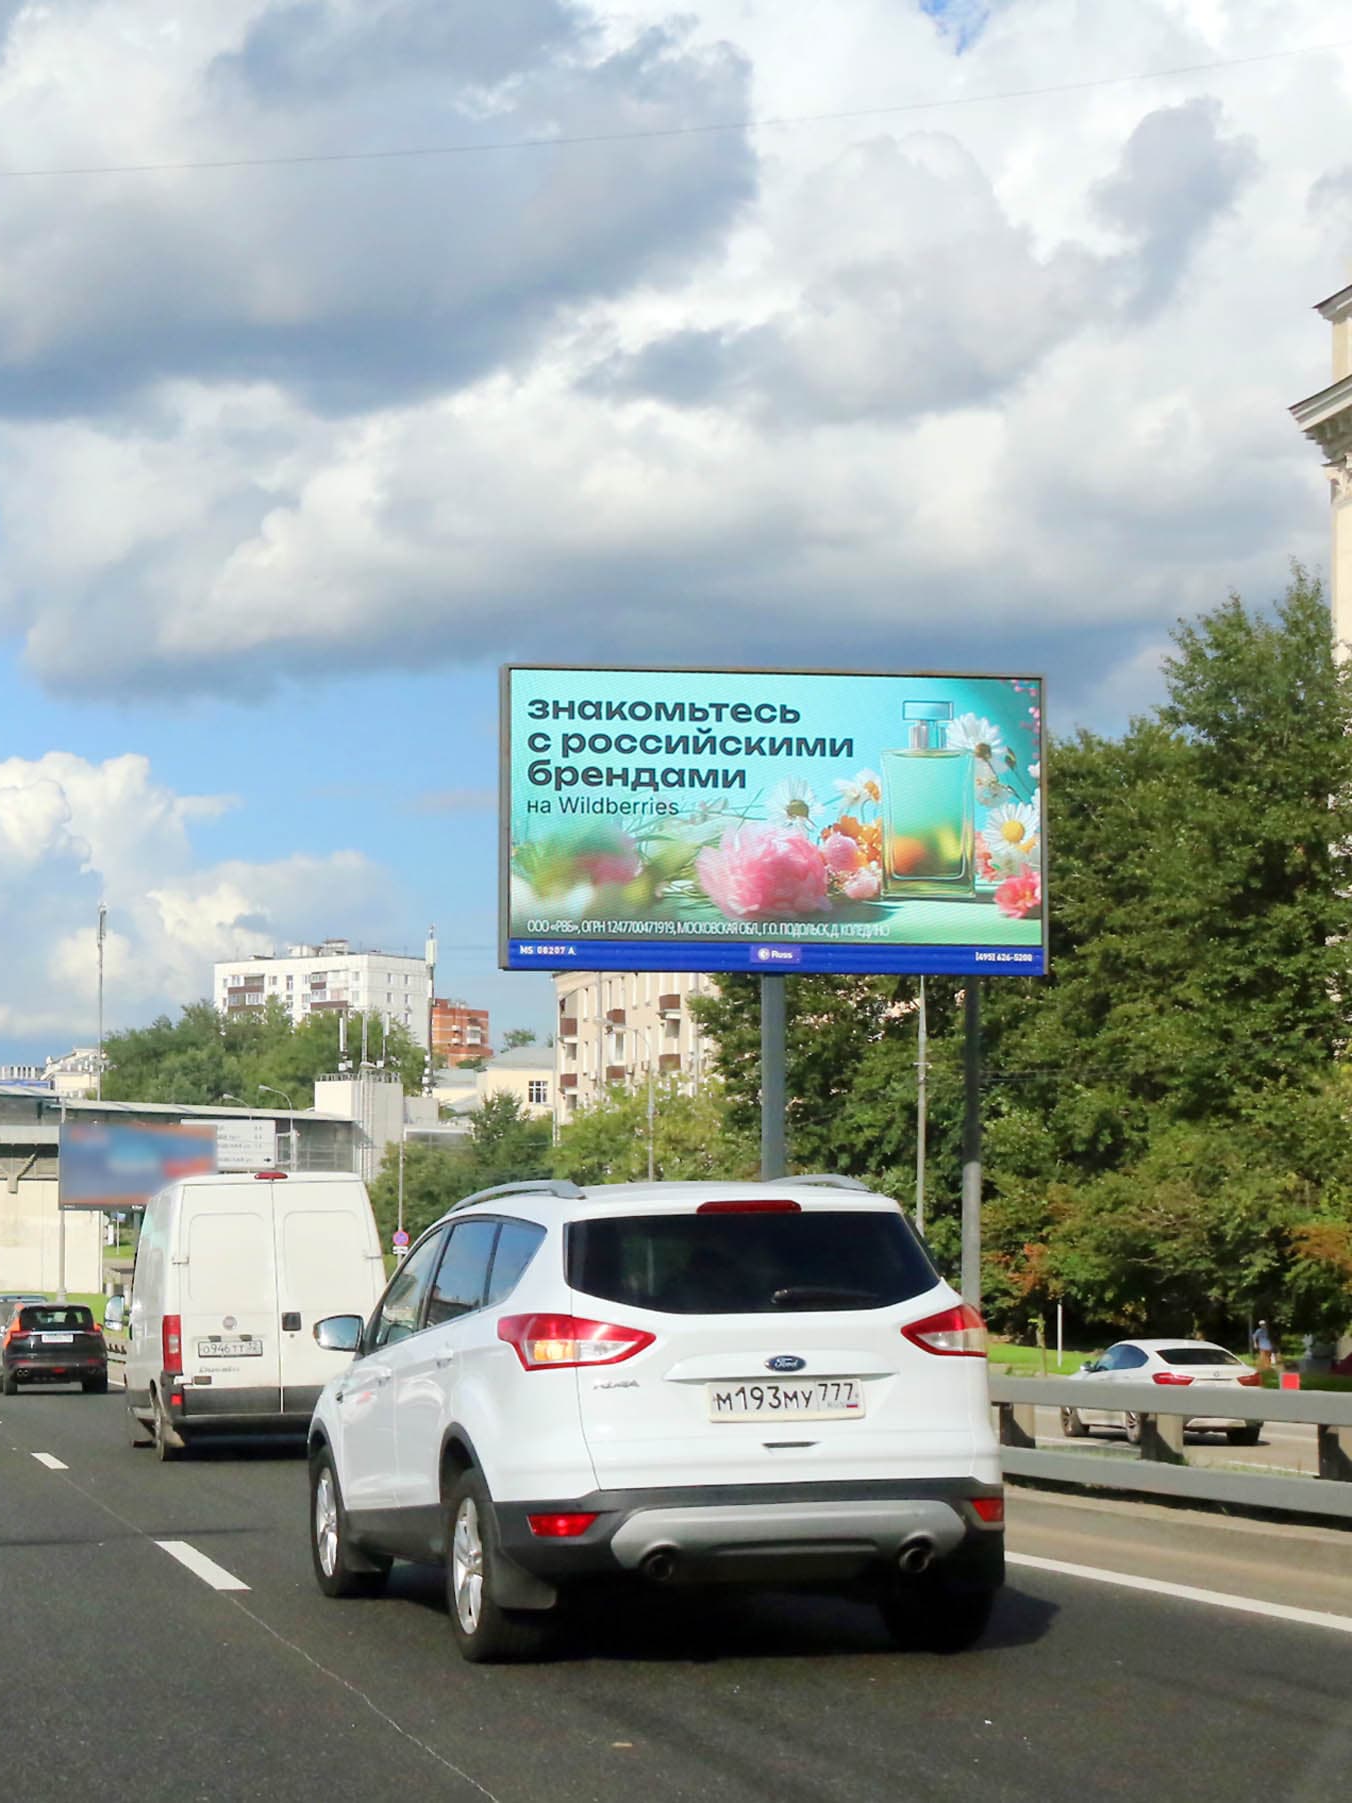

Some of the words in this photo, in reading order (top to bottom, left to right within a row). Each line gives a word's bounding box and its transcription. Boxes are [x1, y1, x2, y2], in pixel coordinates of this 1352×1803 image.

[527, 699, 801, 724] знакомьтесь
[527, 732, 552, 753] с
[561, 727, 854, 758] российскими
[527, 759, 747, 792] брендами
[527, 799, 552, 814] на
[558, 796, 680, 816] Wildberries
[527, 919, 549, 933] ООО
[581, 920, 606, 933] ОГРН
[677, 921, 738, 934] МОСКОВСКАЯ
[771, 950, 793, 959] Russ
[774, 1356, 798, 1369] Ford
[817, 1383, 854, 1401] 777
